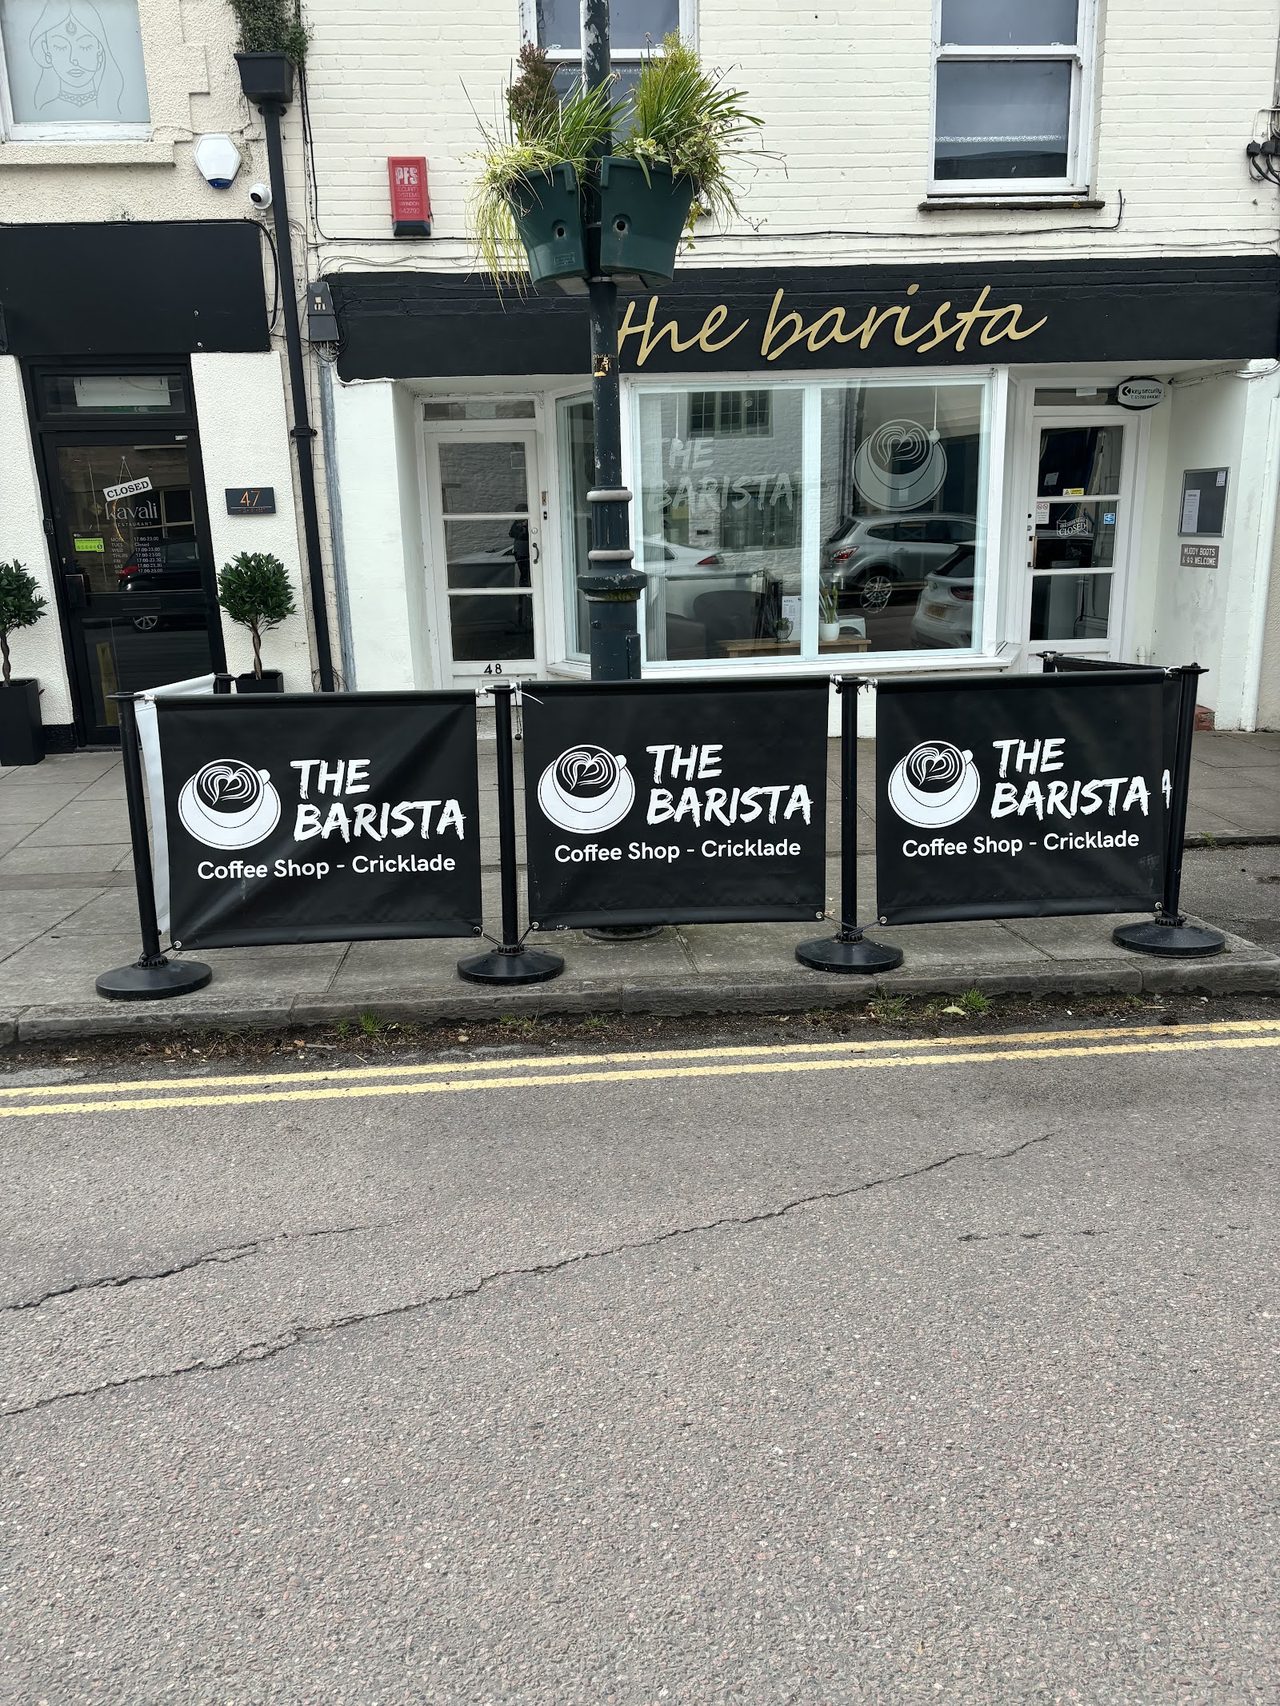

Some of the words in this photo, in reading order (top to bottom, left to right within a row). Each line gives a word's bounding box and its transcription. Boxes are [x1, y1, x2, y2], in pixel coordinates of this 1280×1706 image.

[395, 166, 418, 185] PFS
[617, 295, 750, 366] the
[760, 283, 1048, 361] barista
[107, 480, 149, 498] CLOSED
[240, 490, 260, 507] 47
[1059, 522, 1086, 536] CLOSED
[1194, 556, 1216, 566] WELCOME
[1199, 547, 1216, 556] BOOTS
[484, 663, 503, 675] 48
[646, 744, 723, 784] THE
[992, 737, 1066, 778] THE
[289, 758, 371, 800] THE
[646, 783, 814, 828] BARISTA
[991, 776, 1151, 821] BARISTA
[293, 799, 467, 843] BARISTA
[554, 844, 622, 863] Coffee
[628, 842, 680, 863] Shop
[701, 839, 801, 858] Cricklade
[902, 837, 967, 858] Coffee
[973, 835, 1023, 856] Shop
[1043, 830, 1140, 851] Cricklade
[197, 859, 268, 880] Coffee
[273, 858, 330, 879] Shop
[352, 854, 456, 874] Cricklade
